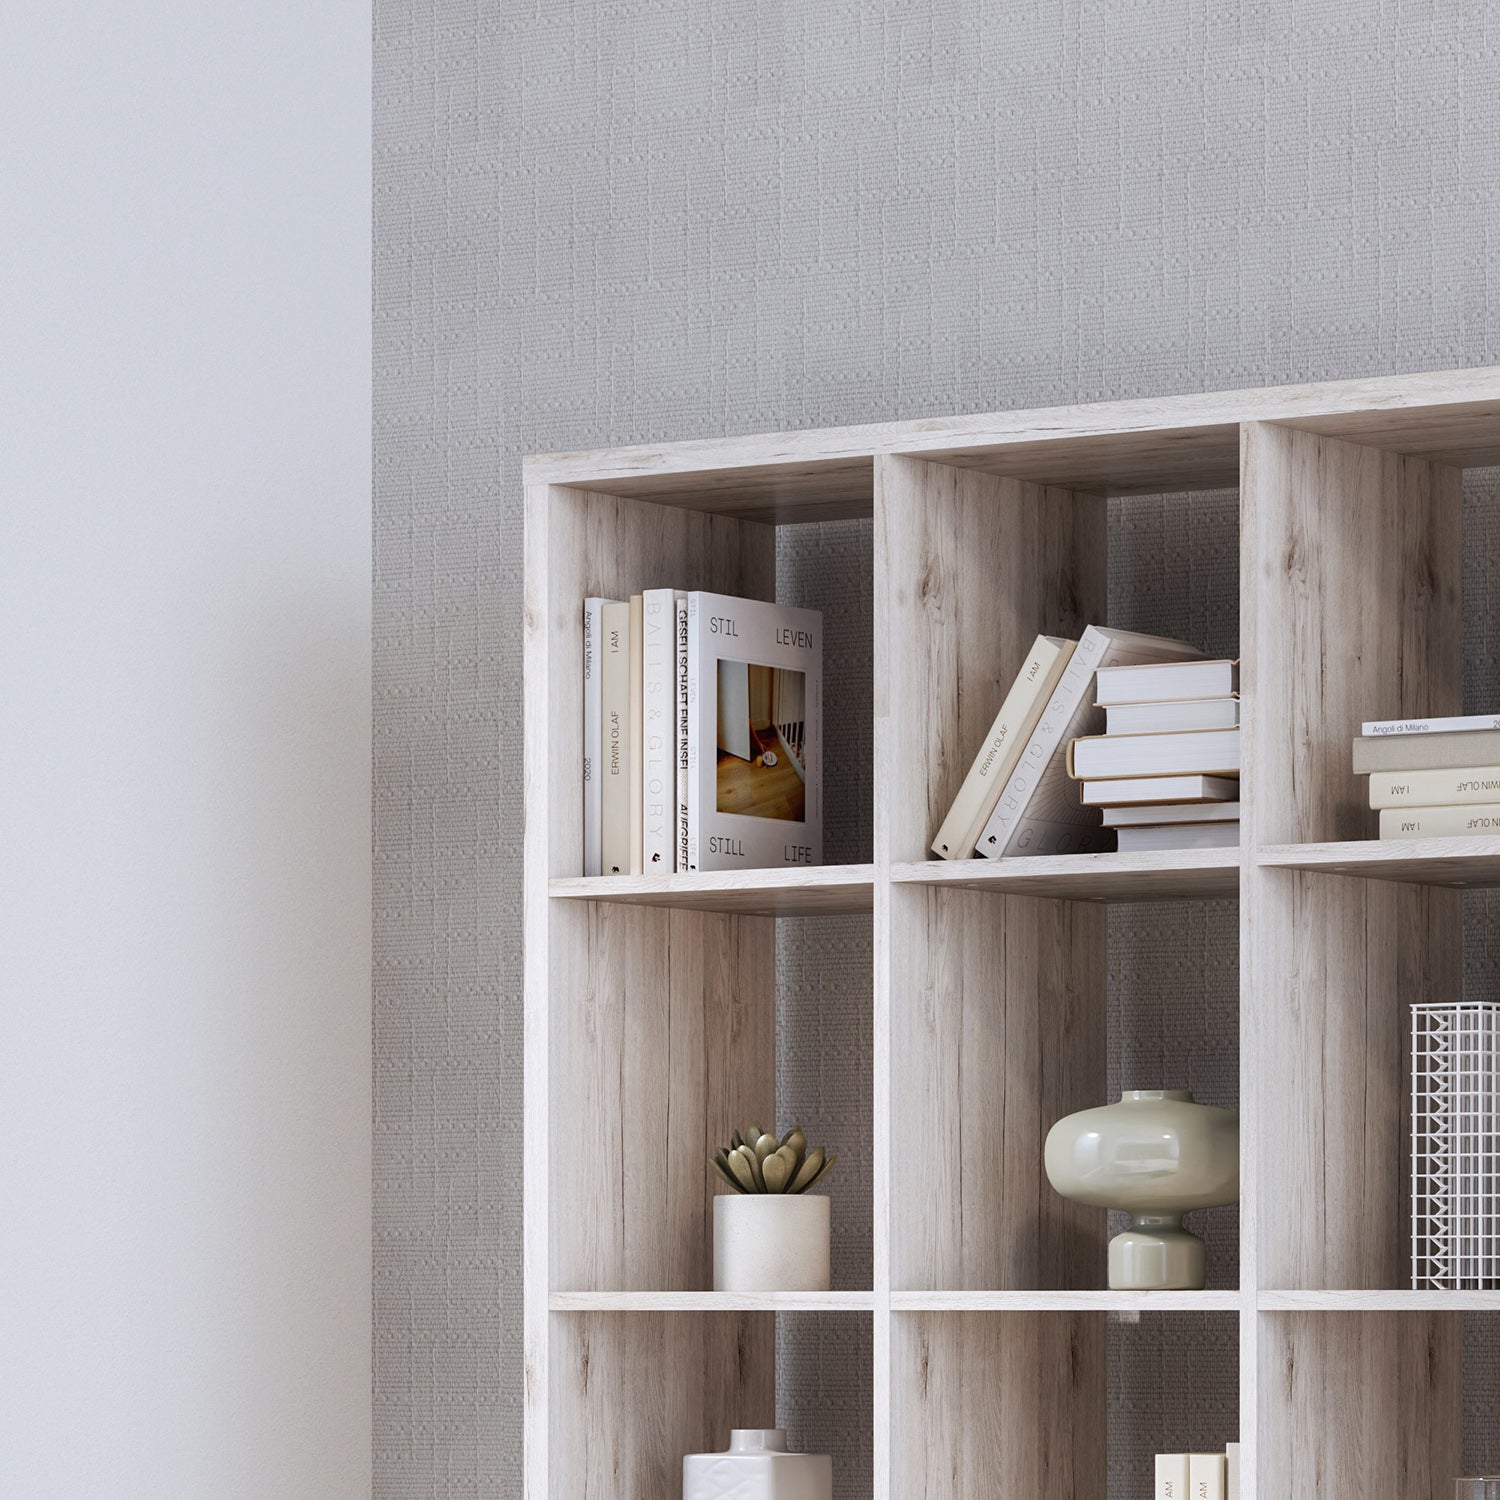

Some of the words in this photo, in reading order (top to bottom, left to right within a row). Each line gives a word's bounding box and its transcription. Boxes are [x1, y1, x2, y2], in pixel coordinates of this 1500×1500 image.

[611, 630, 619, 649] AM
[709, 616, 739, 637] STIL
[776, 627, 813, 649] LEVEN
[1029, 661, 1041, 678] AM
[611, 711, 619, 738] OLAF
[1372, 725, 1395, 735] Angoli
[1396, 724, 1403, 732] di
[1405, 723, 1429, 732] Milano
[611, 740, 619, 775] ERWIN
[979, 746, 998, 777] ERWIN
[994, 722, 1009, 748] OLAF
[583, 757, 592, 781] 2020
[648, 736, 663, 838] GLORY
[997, 743, 1044, 828] GLORY
[1391, 786, 1405, 795] AM
[1457, 781, 1480, 792] OLAF
[1401, 822, 1416, 832] AM
[1467, 818, 1490, 829] OLAF
[709, 836, 745, 856] STILL
[784, 844, 812, 864] LIFE
[1165, 1481, 1173, 1499] AM
[1200, 1481, 1207, 1499] AM
